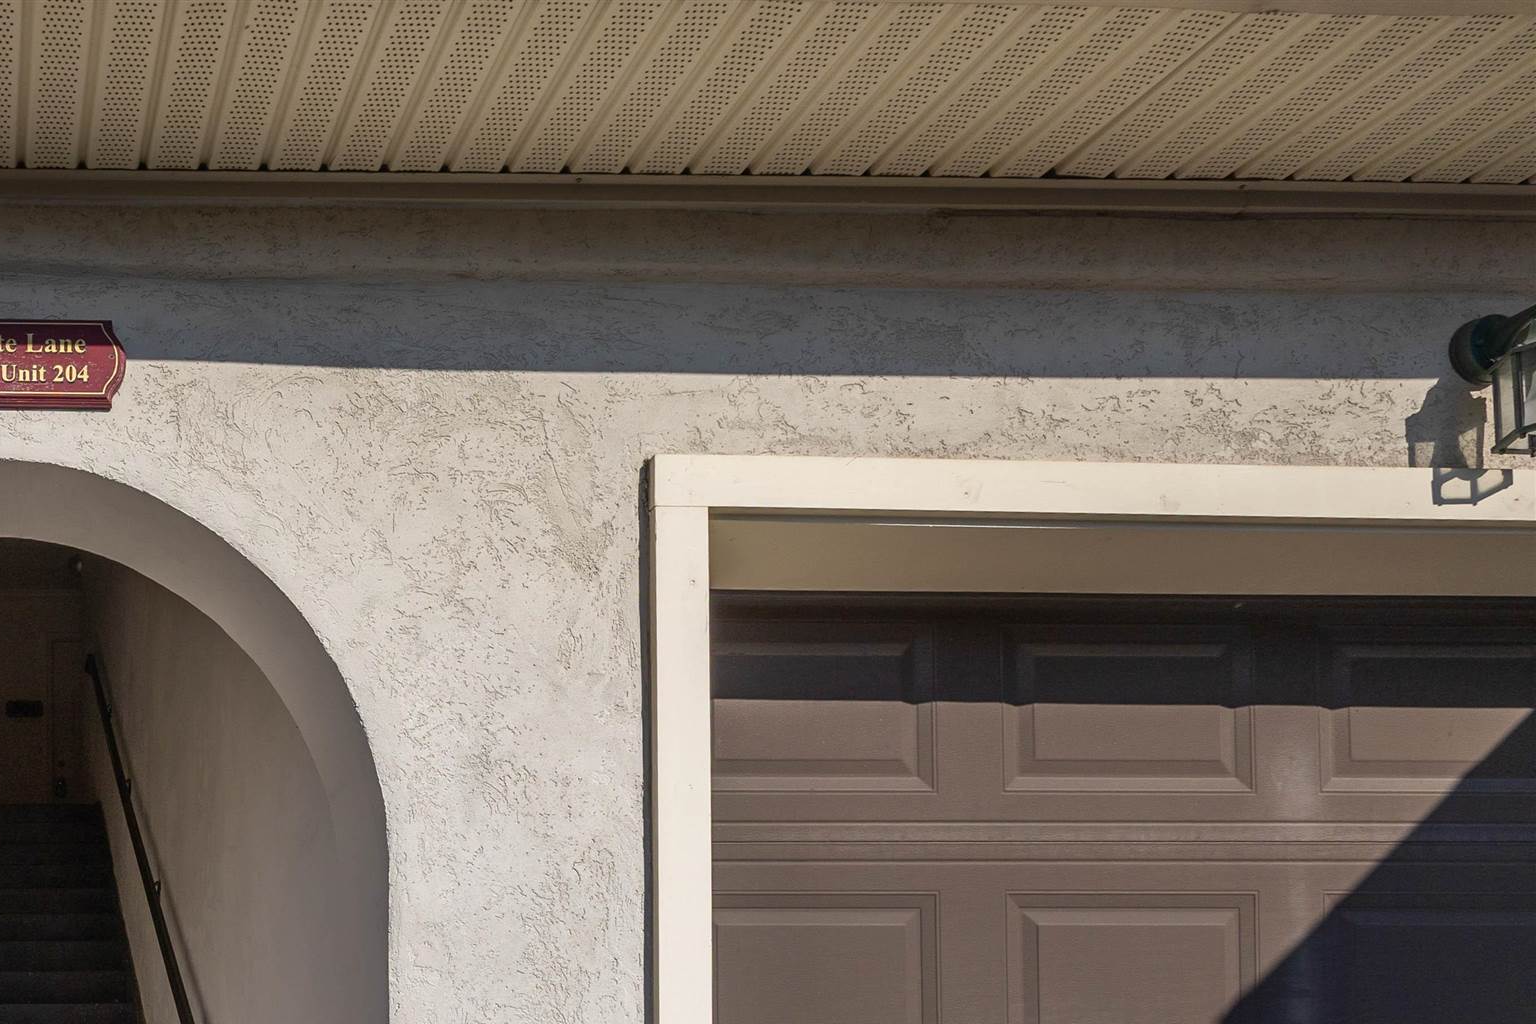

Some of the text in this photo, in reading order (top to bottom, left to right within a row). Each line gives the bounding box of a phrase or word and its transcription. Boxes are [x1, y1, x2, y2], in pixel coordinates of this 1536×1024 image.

[25, 333, 87, 354] Lane
[1, 364, 46, 383] Unit
[52, 365, 89, 383] 204
